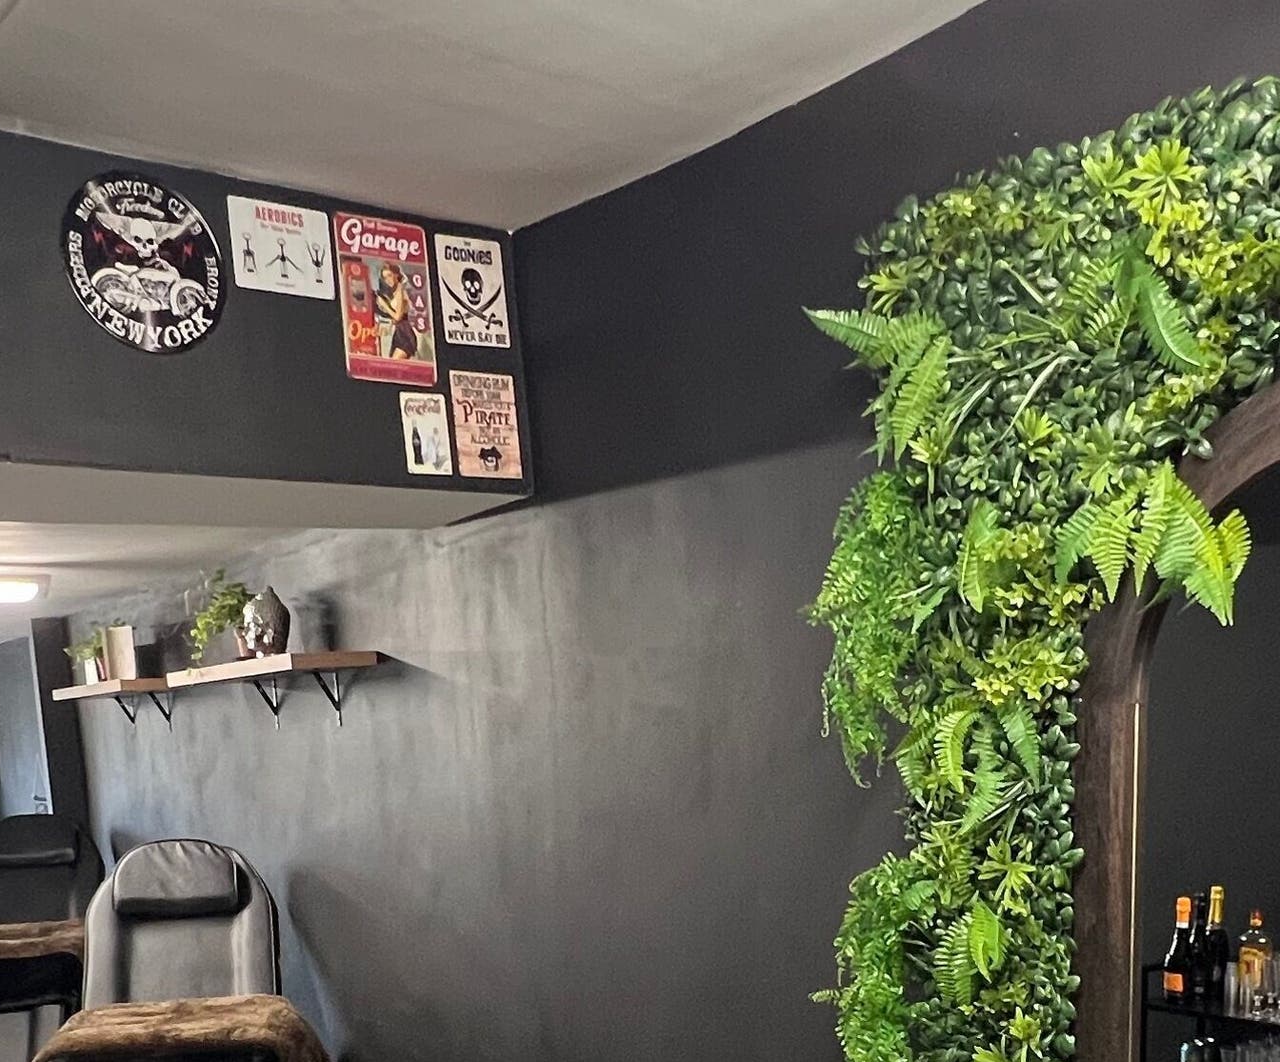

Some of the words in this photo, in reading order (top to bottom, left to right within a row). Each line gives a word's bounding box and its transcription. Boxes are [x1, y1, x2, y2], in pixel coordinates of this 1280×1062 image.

[255, 205, 304, 228] AEROBICS
[340, 218, 421, 260] Garage
[89, 296, 146, 345] NEW
[144, 307, 214, 351] YORK
[448, 330, 477, 342] NEVER
[478, 332, 493, 344] SAY
[456, 398, 511, 428] PIRATE
